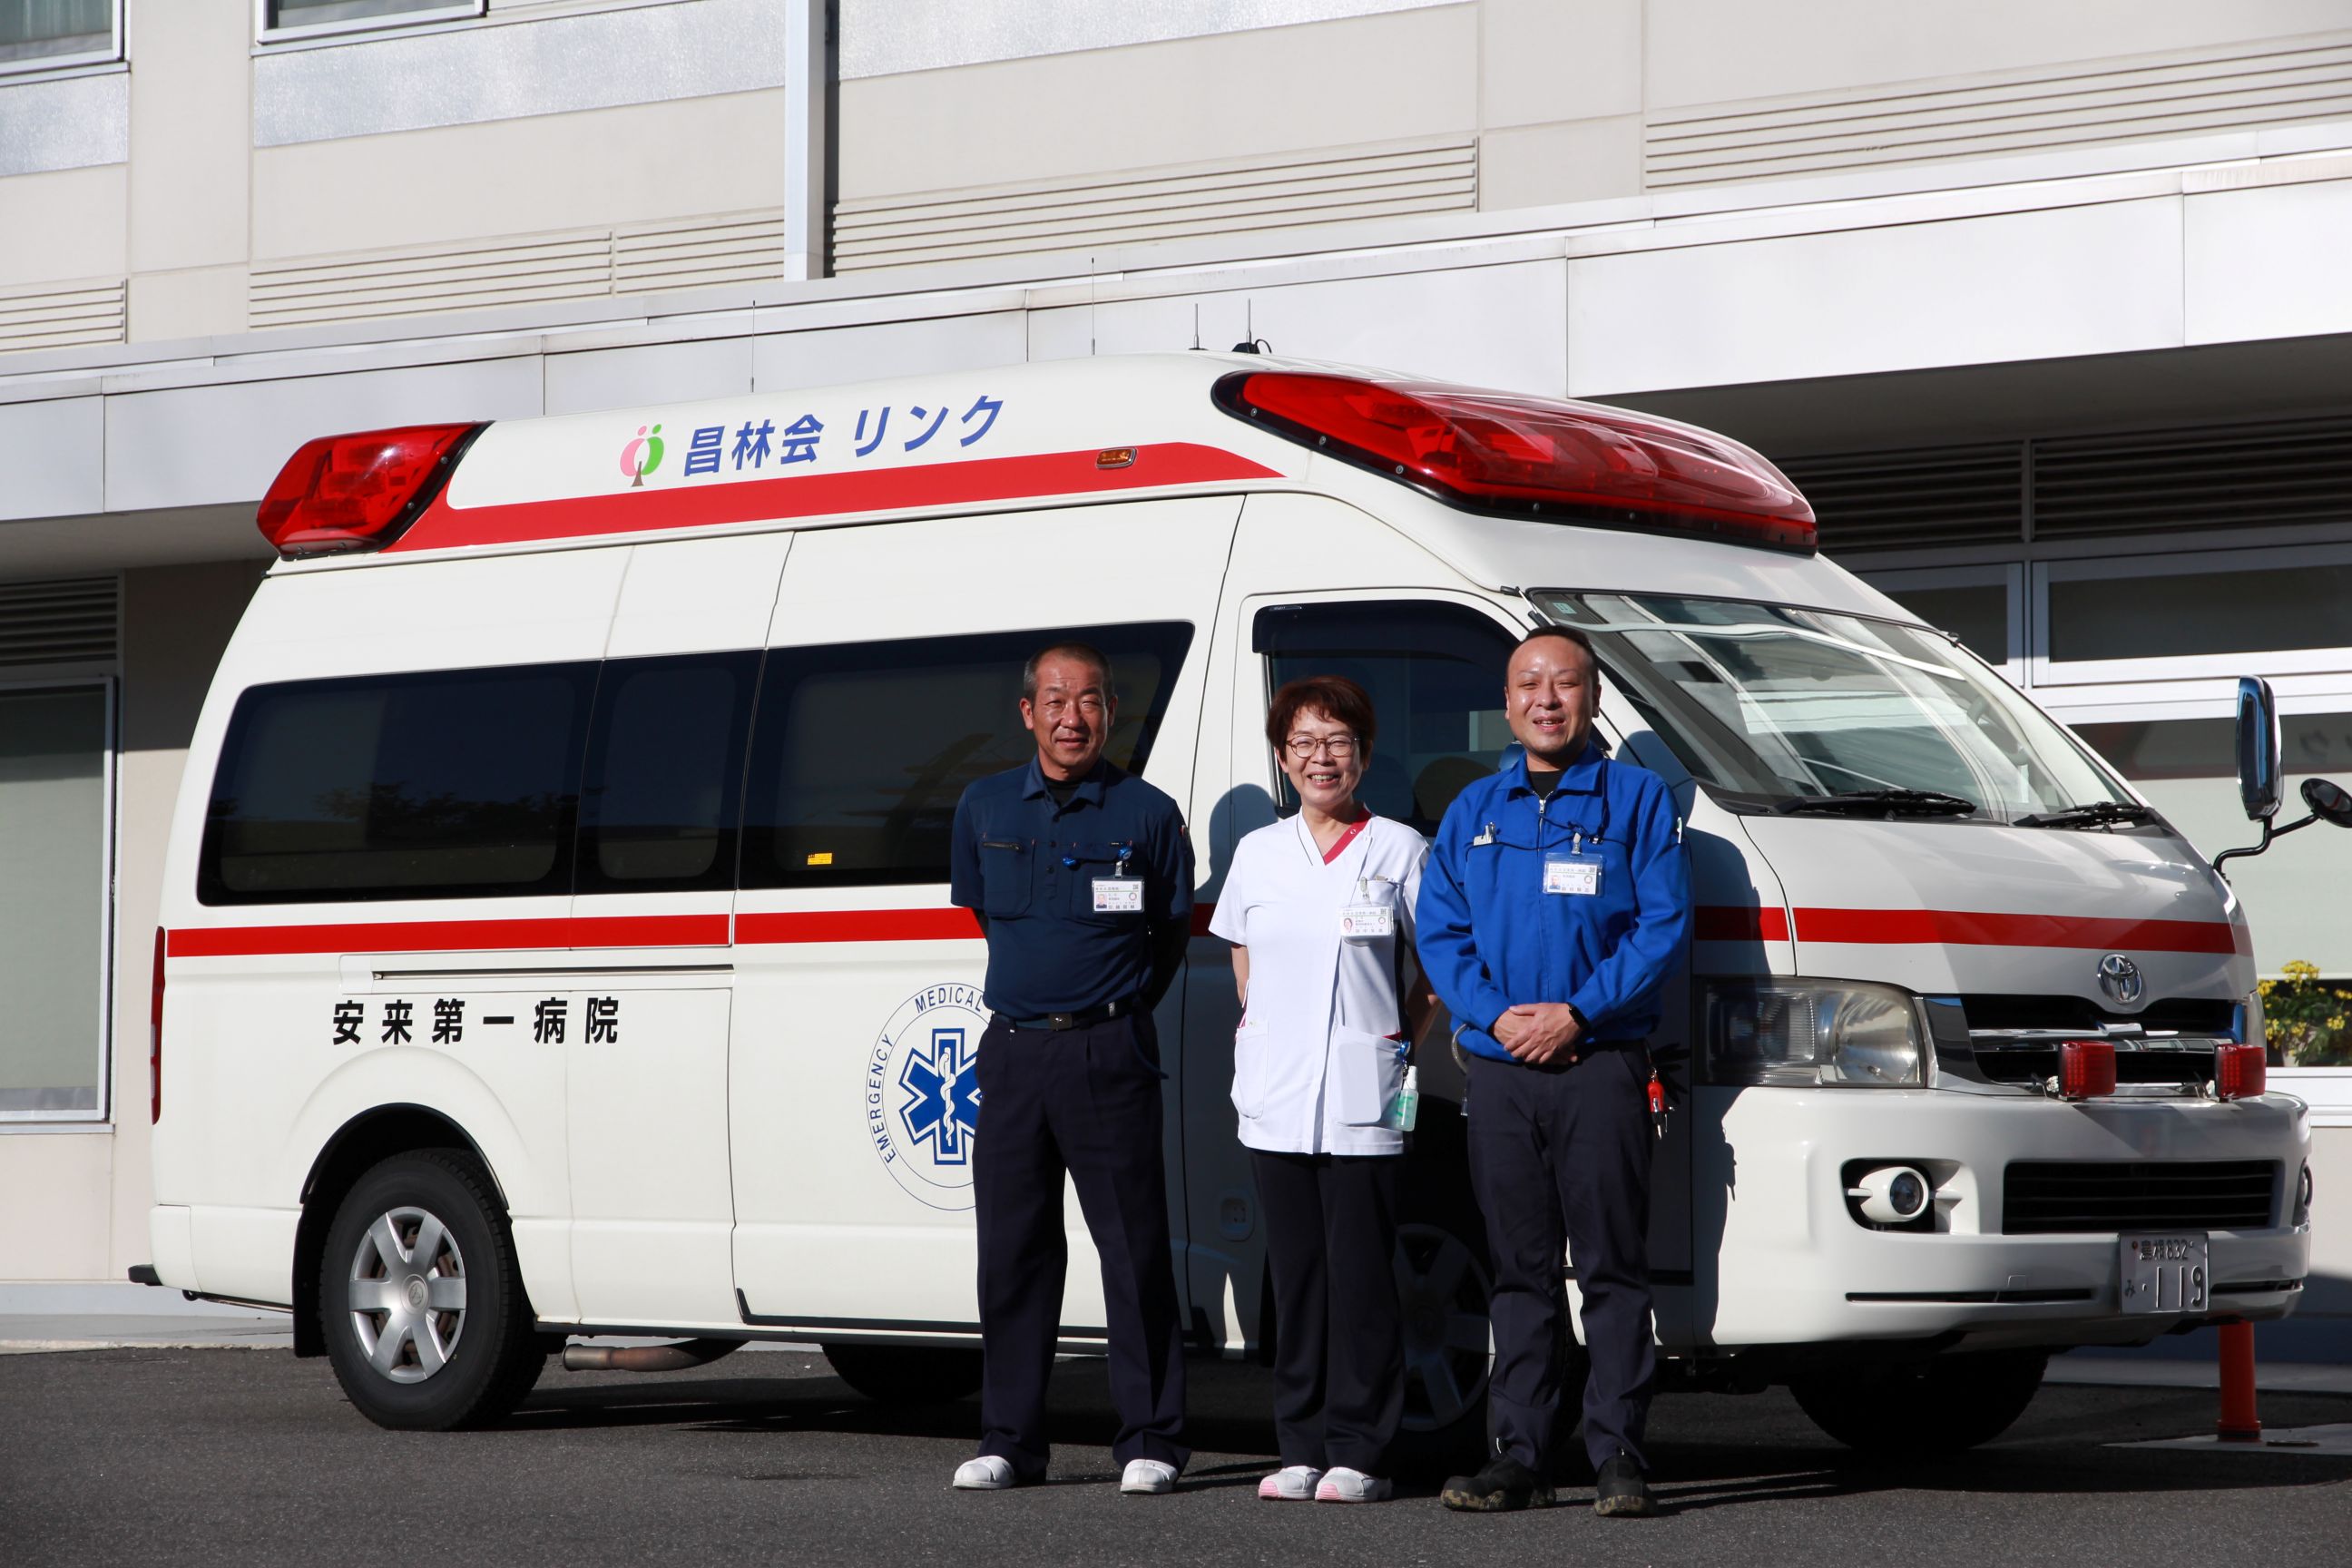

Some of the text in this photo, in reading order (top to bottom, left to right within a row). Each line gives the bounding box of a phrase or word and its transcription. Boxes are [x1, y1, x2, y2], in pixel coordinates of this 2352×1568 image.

[683, 395, 1004, 477] 昌林会 リンク
[332, 996, 619, 1045] 安来第一病院
[868, 986, 983, 1164] EMERGENCY MEDICAL
